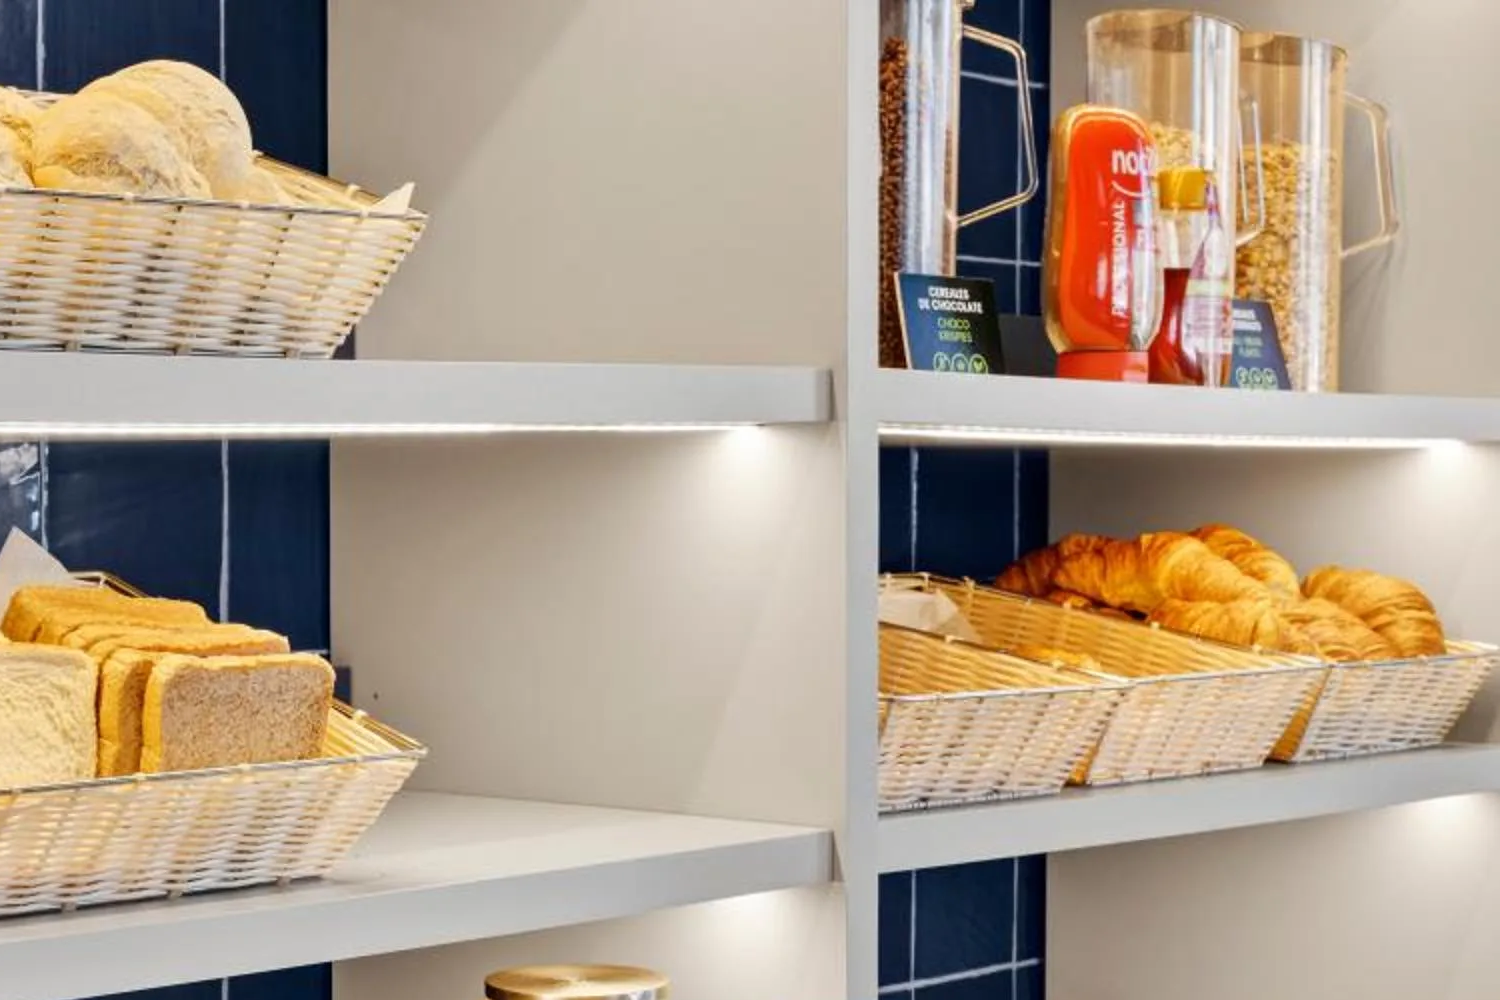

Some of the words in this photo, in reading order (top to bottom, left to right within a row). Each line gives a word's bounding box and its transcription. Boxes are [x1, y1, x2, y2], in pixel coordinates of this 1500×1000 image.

[927, 286, 969, 301] CEREALES
[917, 297, 931, 311] DE
[931, 299, 984, 315] CHOCOLATE
